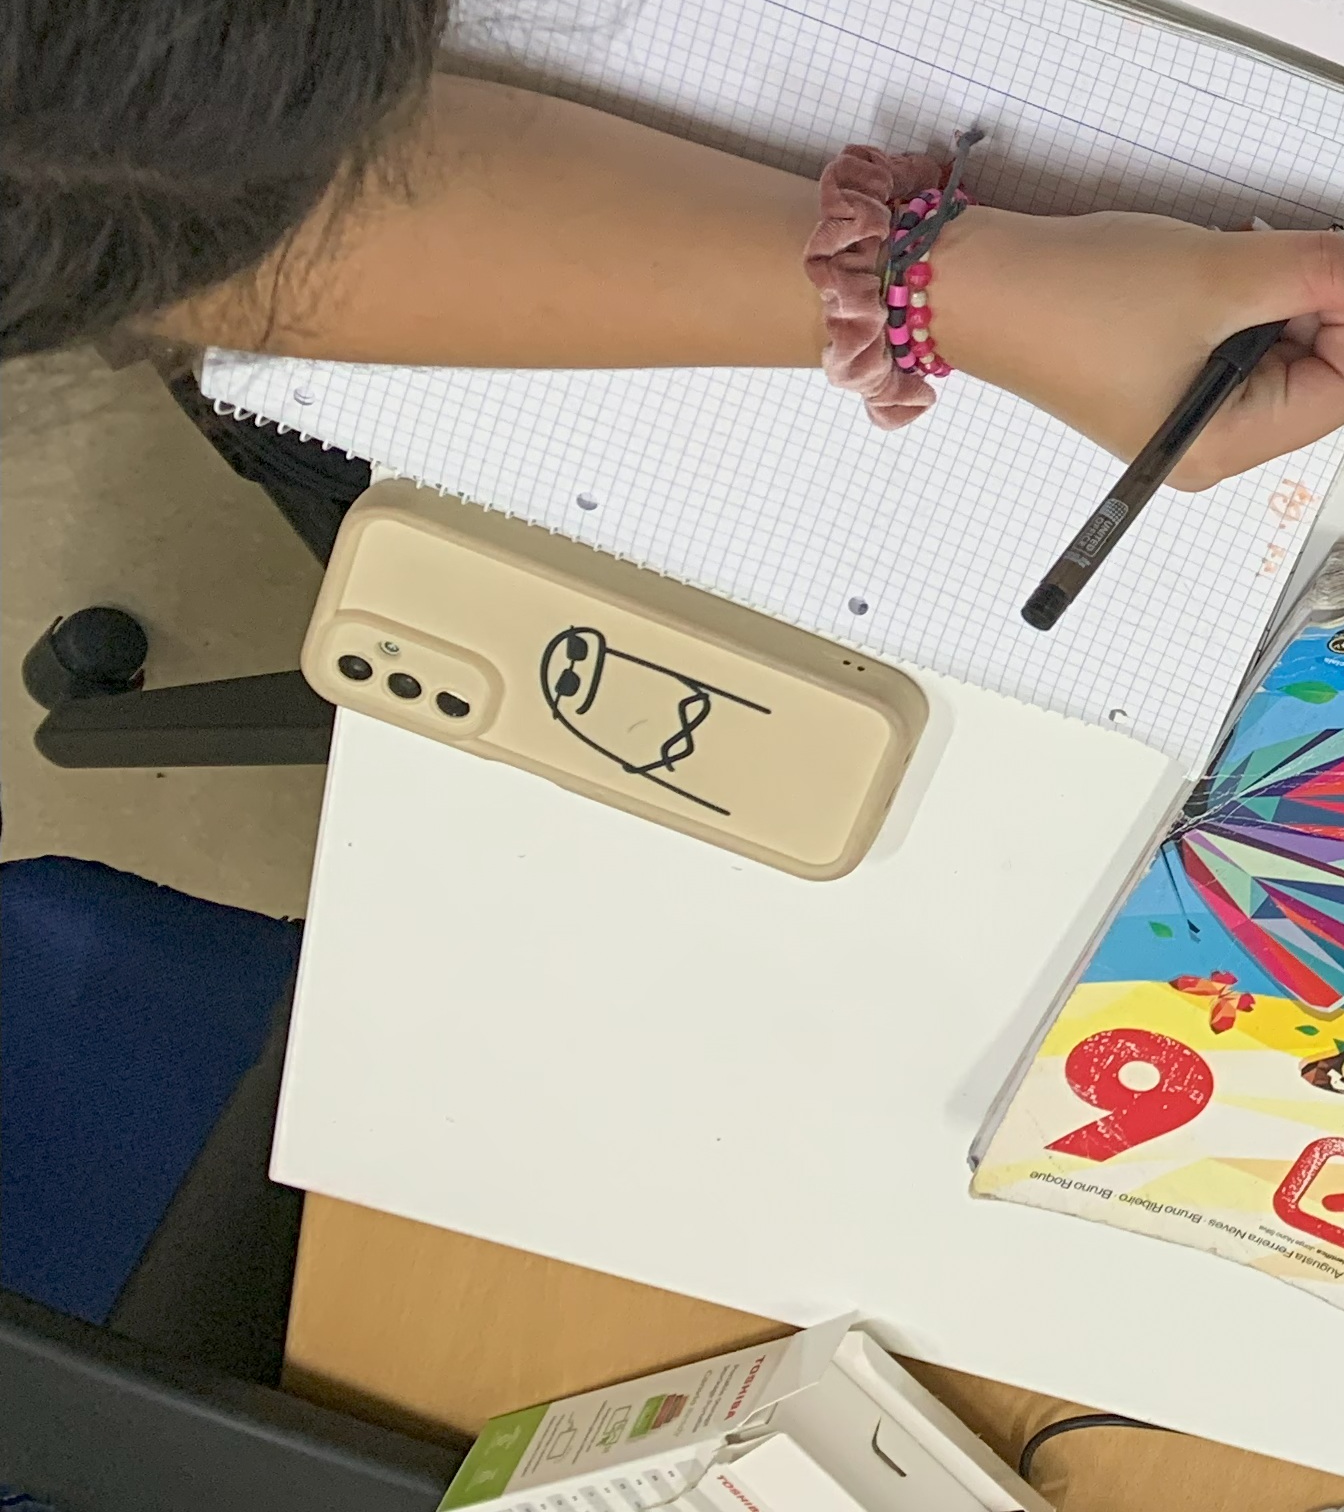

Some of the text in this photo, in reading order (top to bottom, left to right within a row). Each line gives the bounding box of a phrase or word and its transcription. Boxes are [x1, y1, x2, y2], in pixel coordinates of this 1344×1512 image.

[1077, 516, 1104, 546] OFFICE
[1085, 520, 1112, 551] UNITED
[1044, 1028, 1214, 1161] 6
[1029, 1170, 1113, 1199] Bruno Roque
[1118, 1193, 1202, 1223] Bruno Ribeiro
[1207, 1218, 1247, 1239] Neves
[1247, 1233, 1294, 1258] Ferreira
[1294, 1252, 1344, 1279] Augusta
[724, 1355, 766, 1420] TOSHIBA
[717, 1475, 760, 1512] TOSHIB
